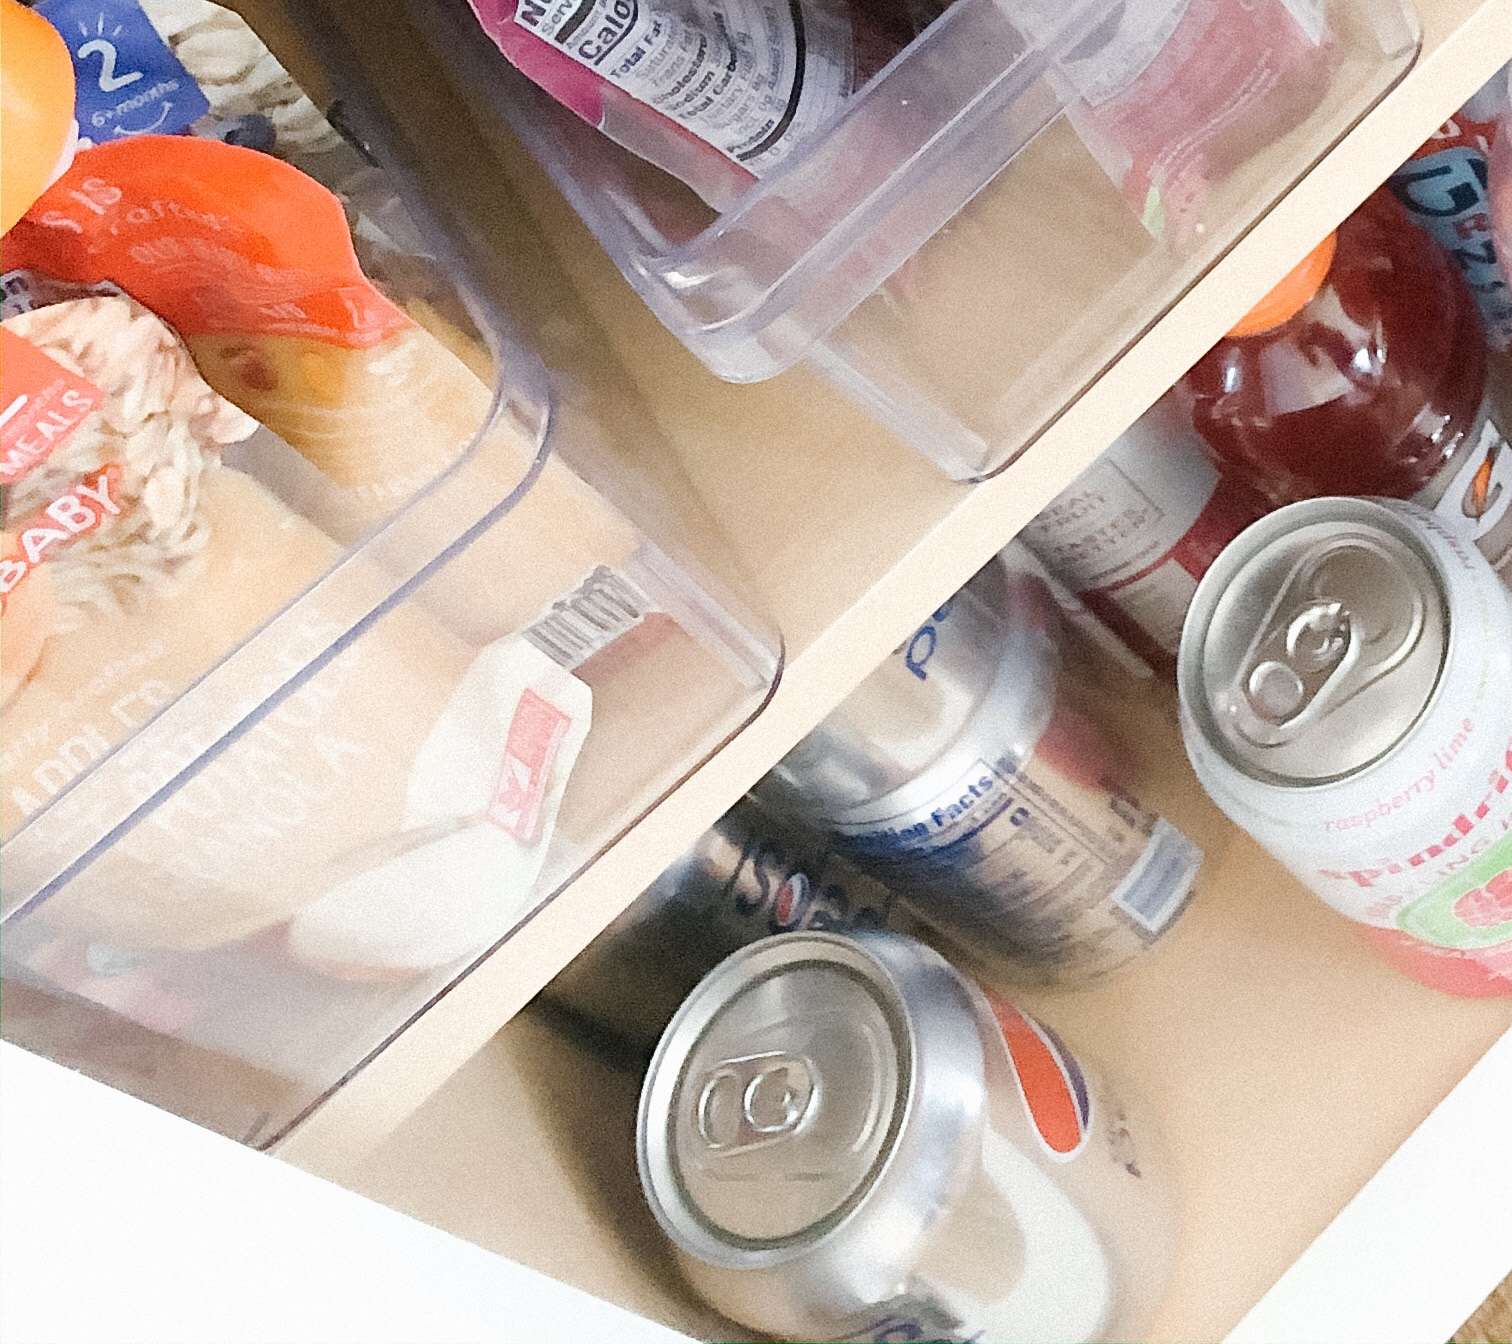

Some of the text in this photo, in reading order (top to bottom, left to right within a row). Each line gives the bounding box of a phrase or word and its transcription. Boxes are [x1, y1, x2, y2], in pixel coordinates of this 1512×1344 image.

[76, 39, 143, 93] 2
[0, 387, 96, 477] MEALS
[1436, 717, 1474, 771] lime
